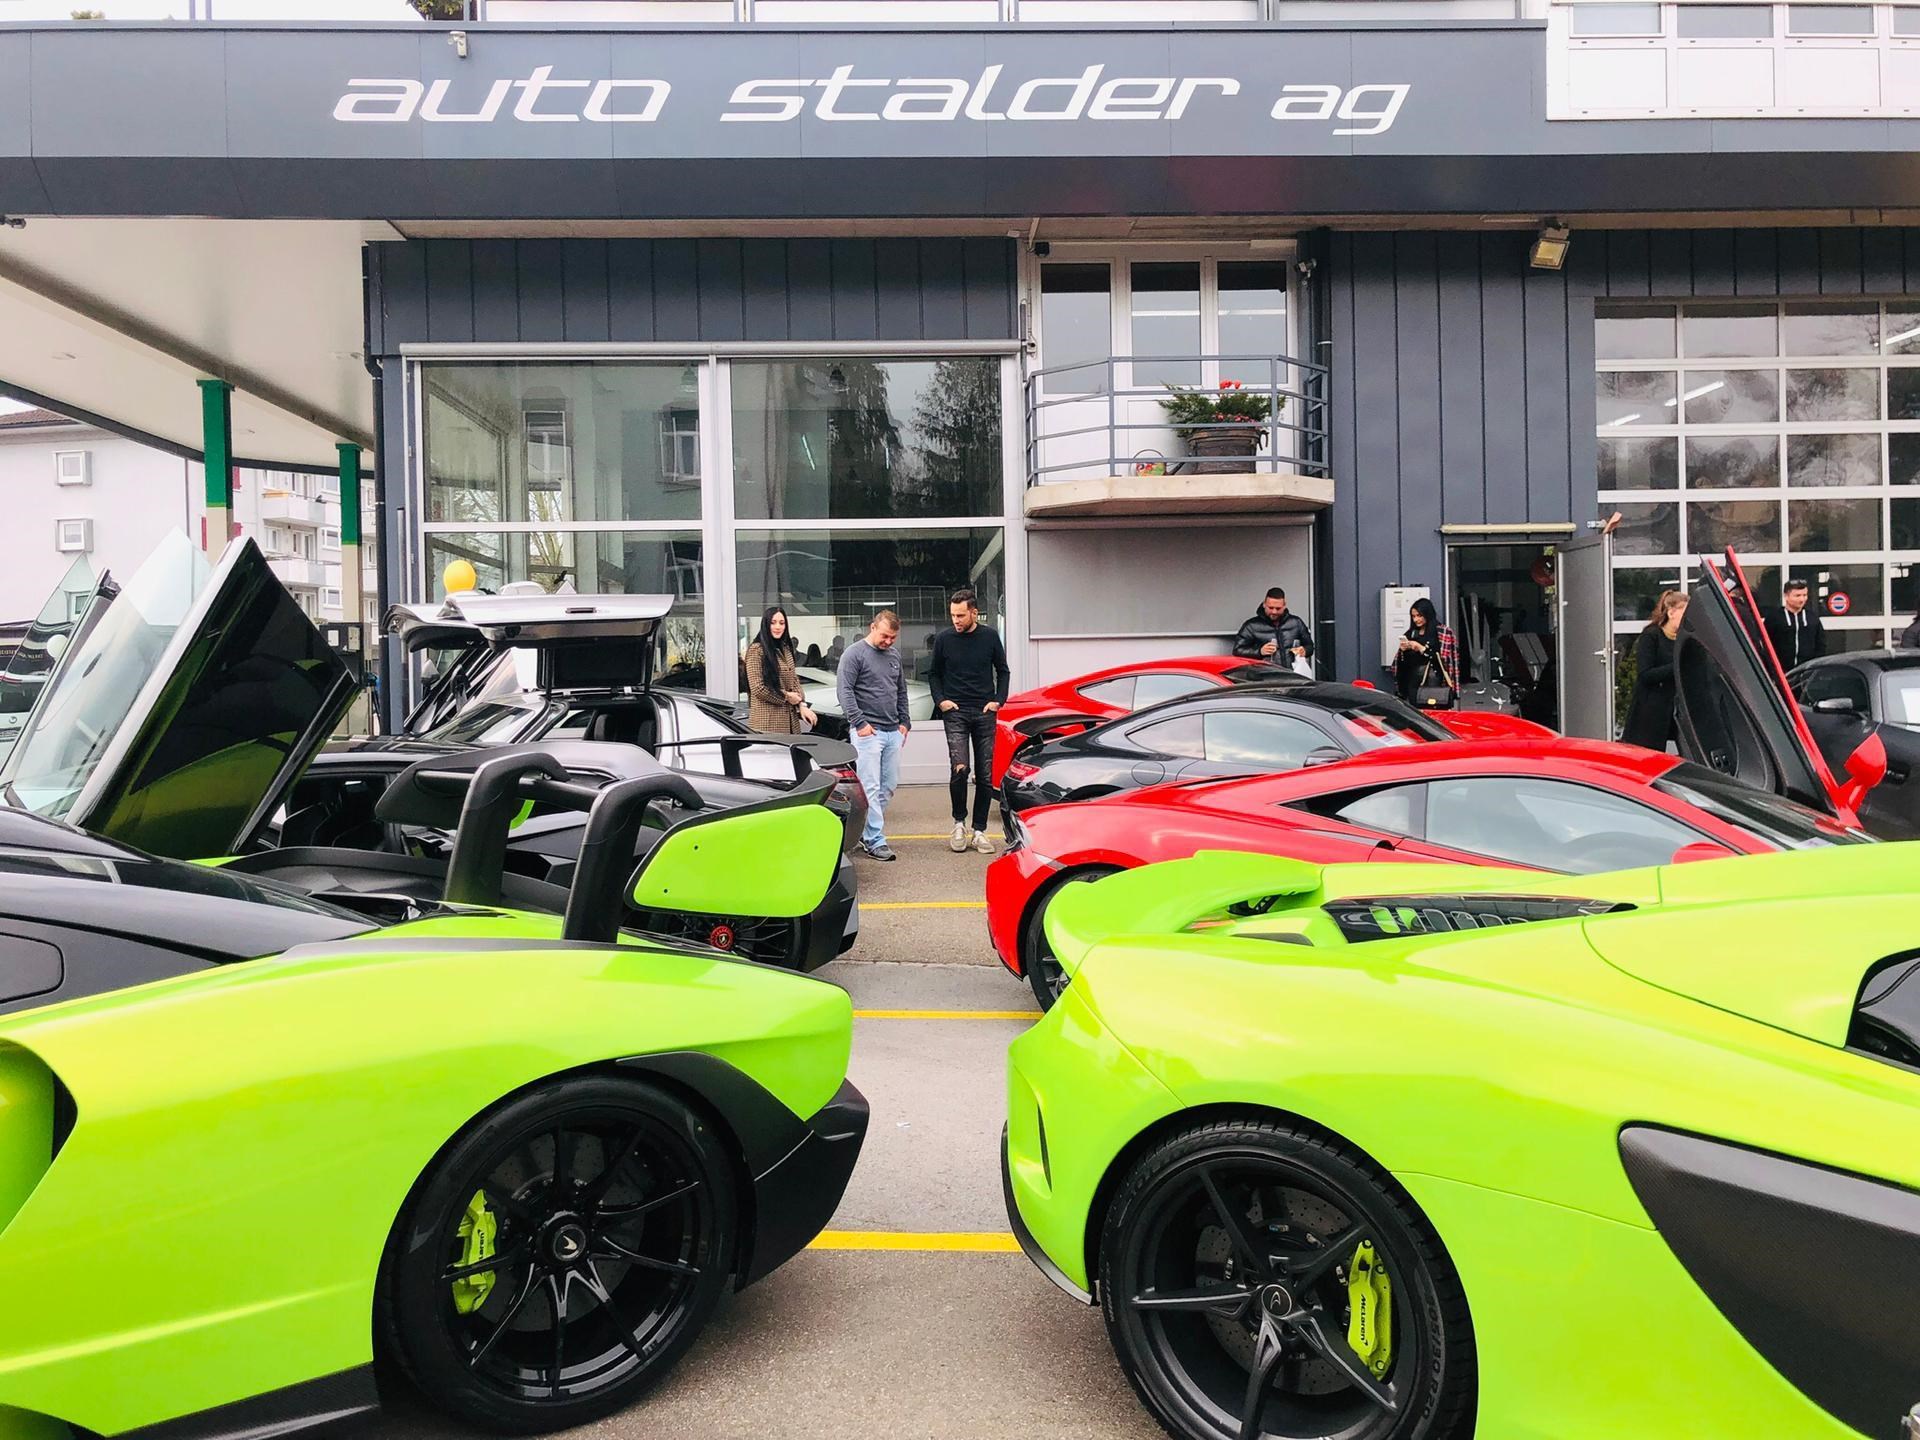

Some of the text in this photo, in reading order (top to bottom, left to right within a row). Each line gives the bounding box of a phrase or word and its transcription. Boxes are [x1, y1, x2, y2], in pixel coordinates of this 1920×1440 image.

[333, 64, 1411, 136] auto stalder ag
